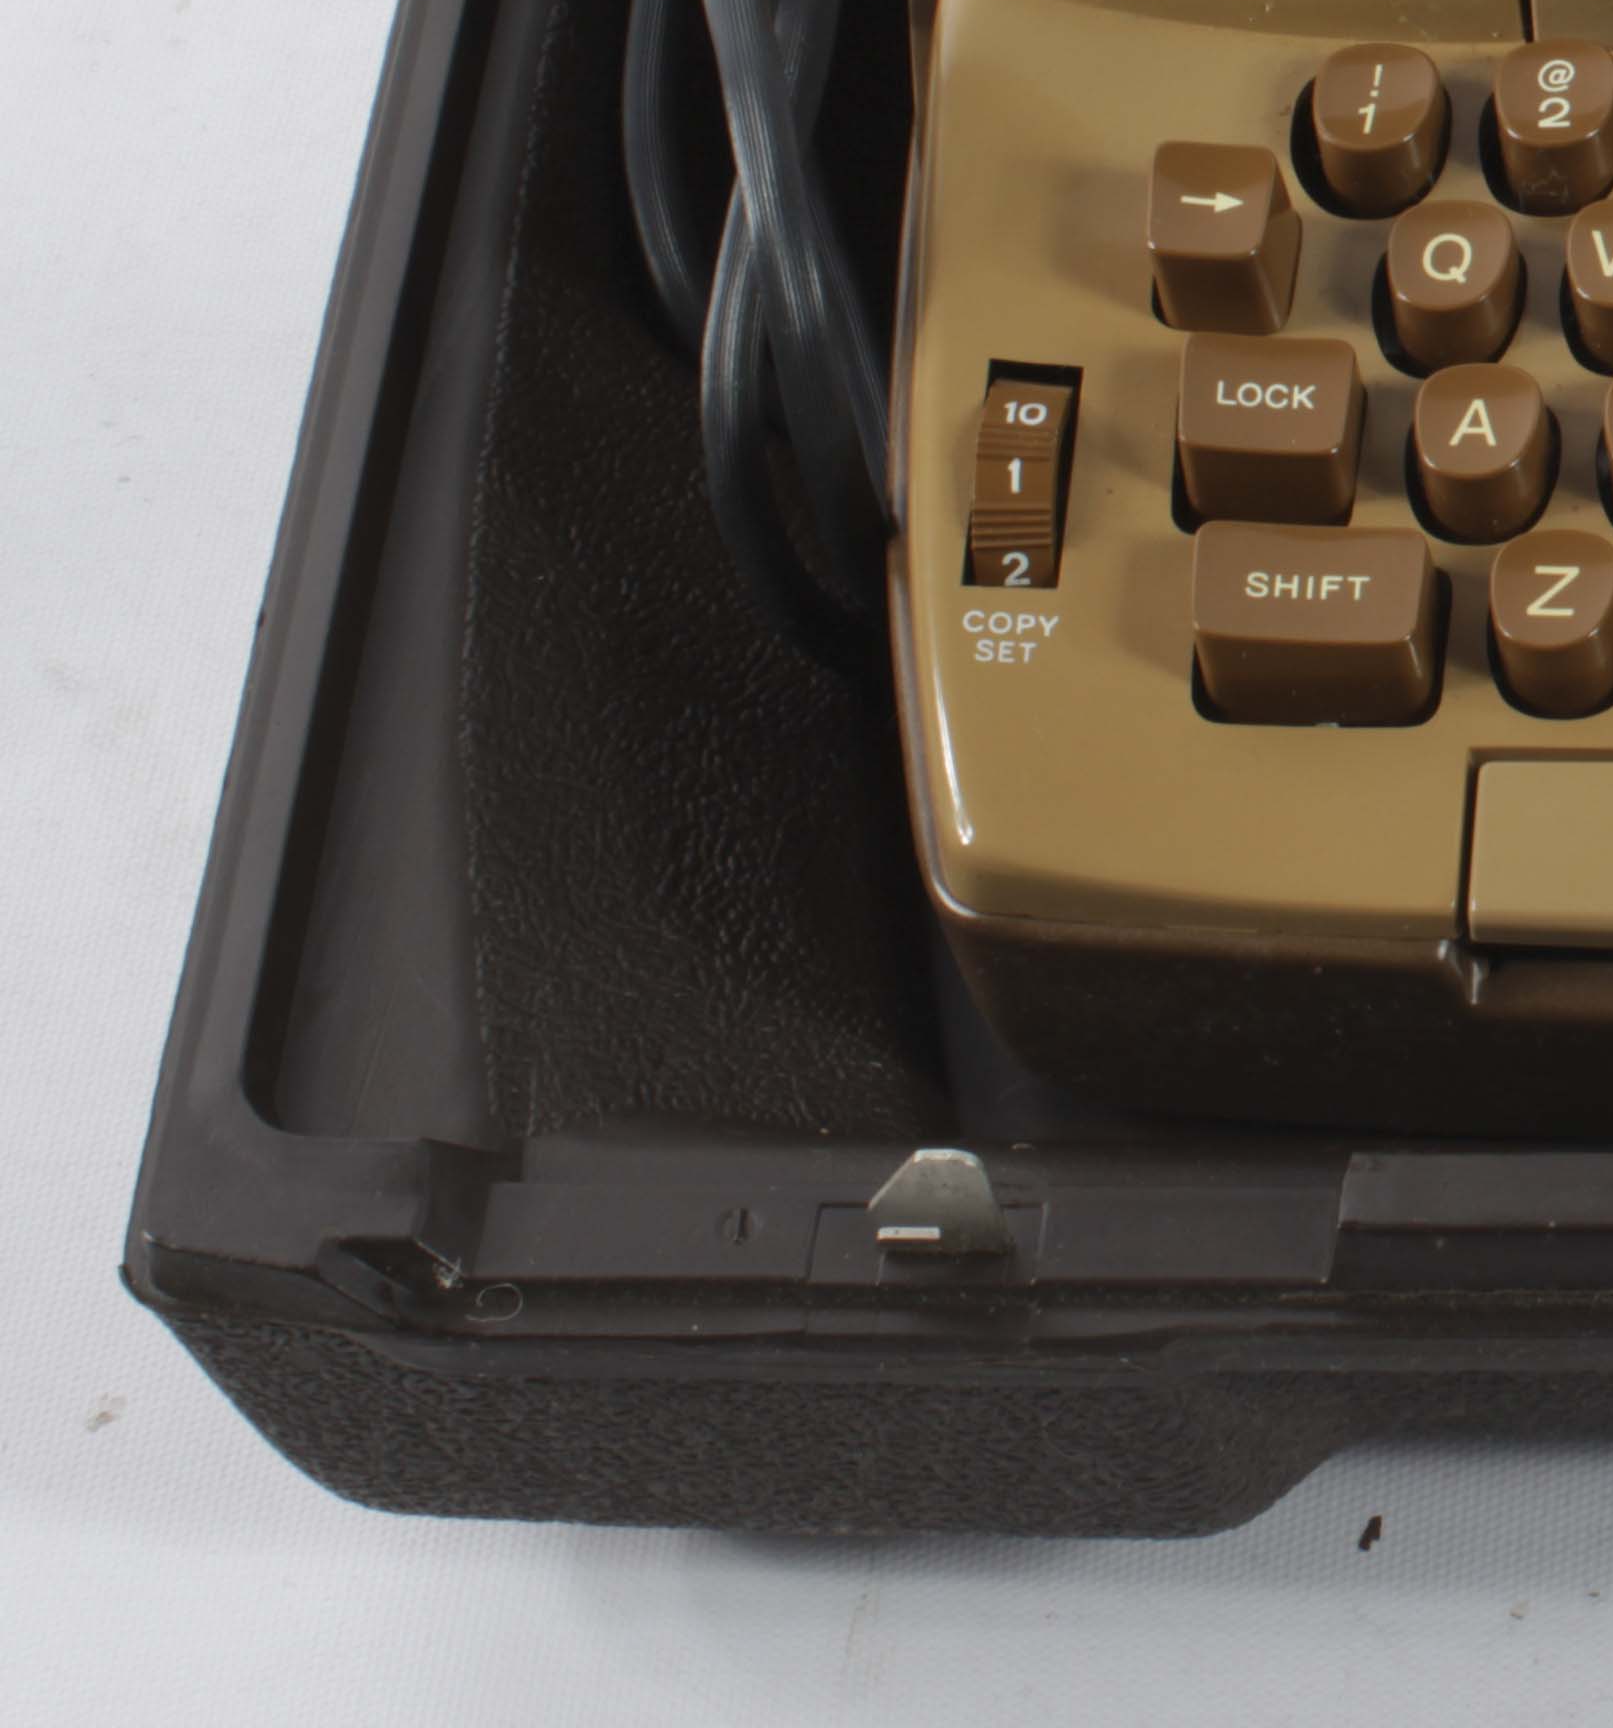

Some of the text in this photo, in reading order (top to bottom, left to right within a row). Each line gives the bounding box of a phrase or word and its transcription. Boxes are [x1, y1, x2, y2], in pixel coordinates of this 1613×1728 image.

[1537, 60, 1574, 92] @
[1358, 103, 1375, 134] 1
[1538, 98, 1571, 129] 2
[1422, 234, 1472, 283] Q
[1216, 381, 1316, 410] LOCK
[1004, 401, 1048, 424] 10
[1449, 399, 1498, 446] A
[1007, 459, 1021, 493] 1
[1002, 554, 1031, 586] 2
[1244, 573, 1370, 601] SHIFT
[1526, 566, 1580, 616] Z
[962, 610, 1059, 637] COPY
[974, 639, 1037, 663] SET
